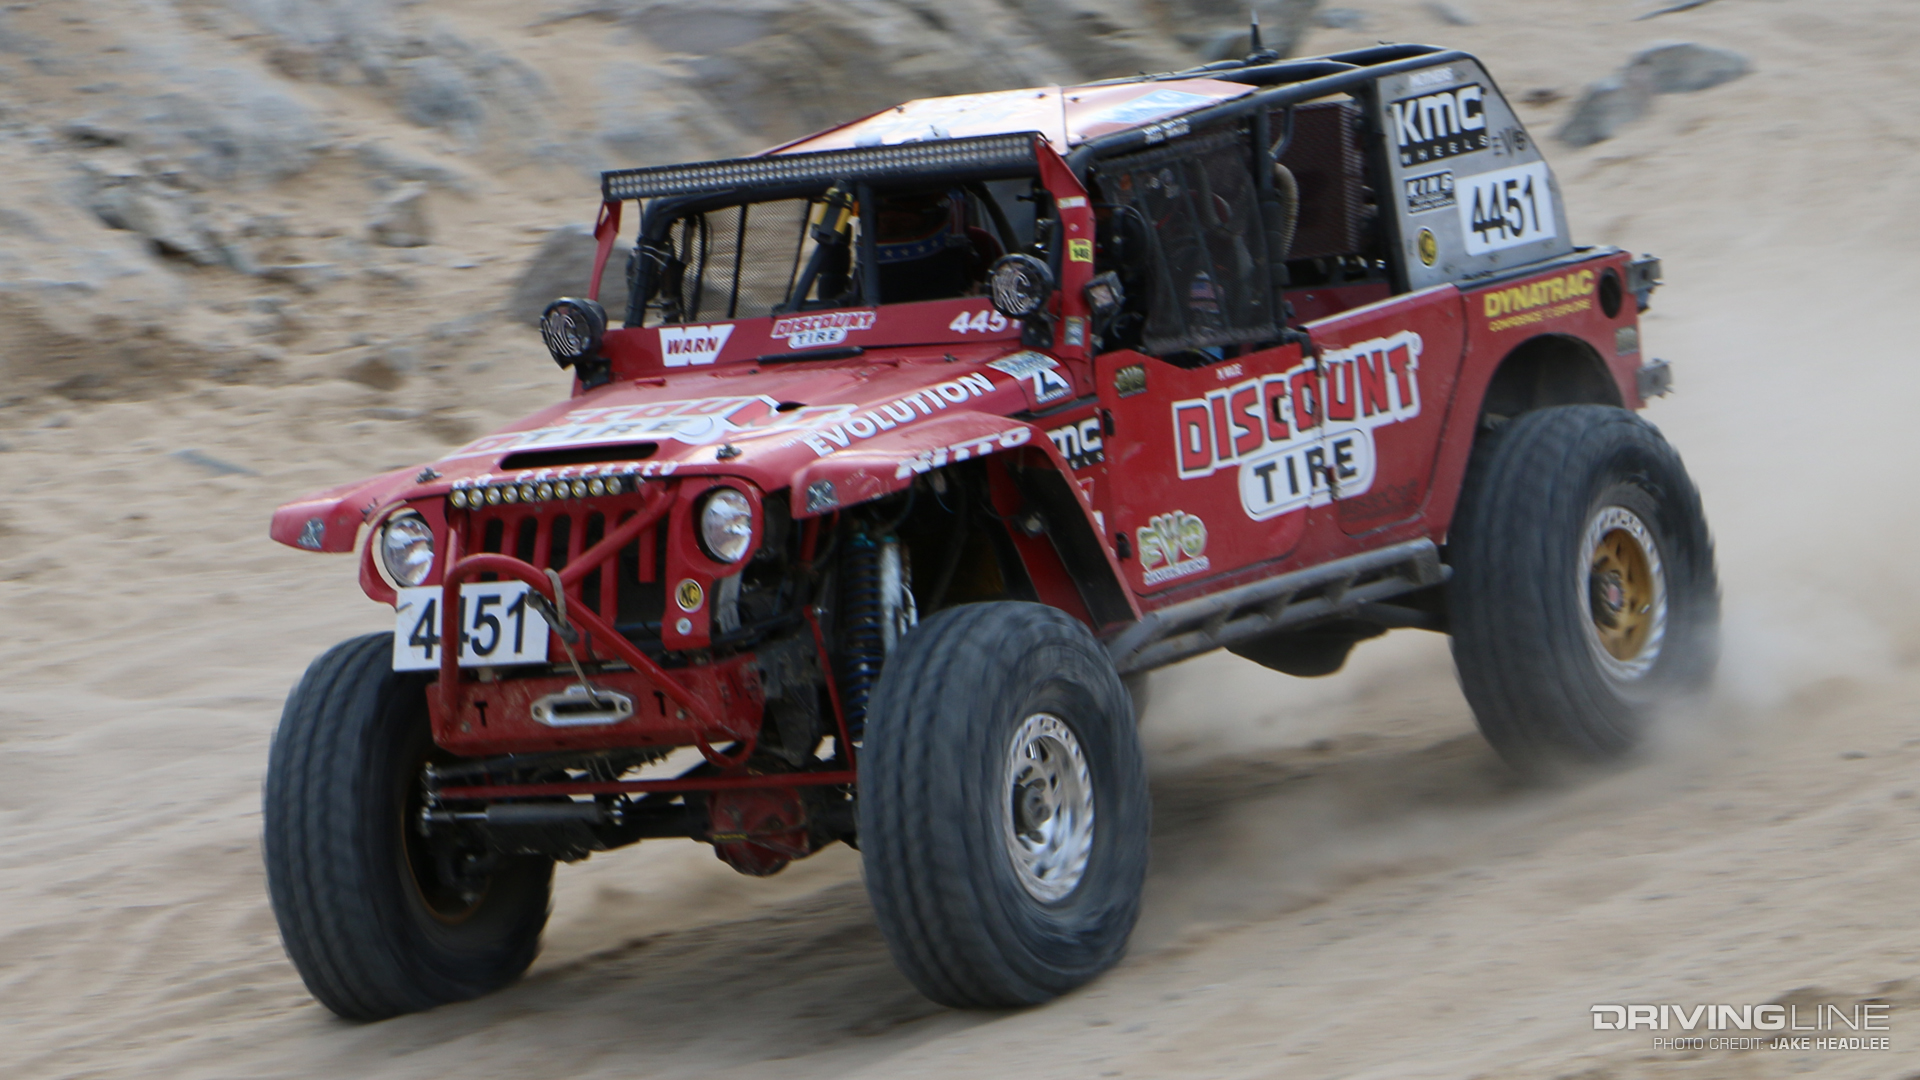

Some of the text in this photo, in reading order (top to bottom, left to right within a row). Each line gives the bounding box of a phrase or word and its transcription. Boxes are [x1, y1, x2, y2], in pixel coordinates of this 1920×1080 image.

[1400, 135, 1489, 165] WHEELS
[1406, 174, 1453, 198] KING
[1472, 175, 1540, 244] 4451
[1483, 269, 1595, 318] DYNATRAC
[668, 337, 719, 355] WARN
[771, 311, 877, 339] DISCOUNT
[797, 330, 839, 345] TIRE
[803, 372, 997, 458] EVOLUTION
[1174, 340, 1417, 475] DISCOUNT
[895, 427, 1032, 480] NITTO
[1046, 417, 1103, 459] MC
[1254, 438, 1357, 503] TIRE
